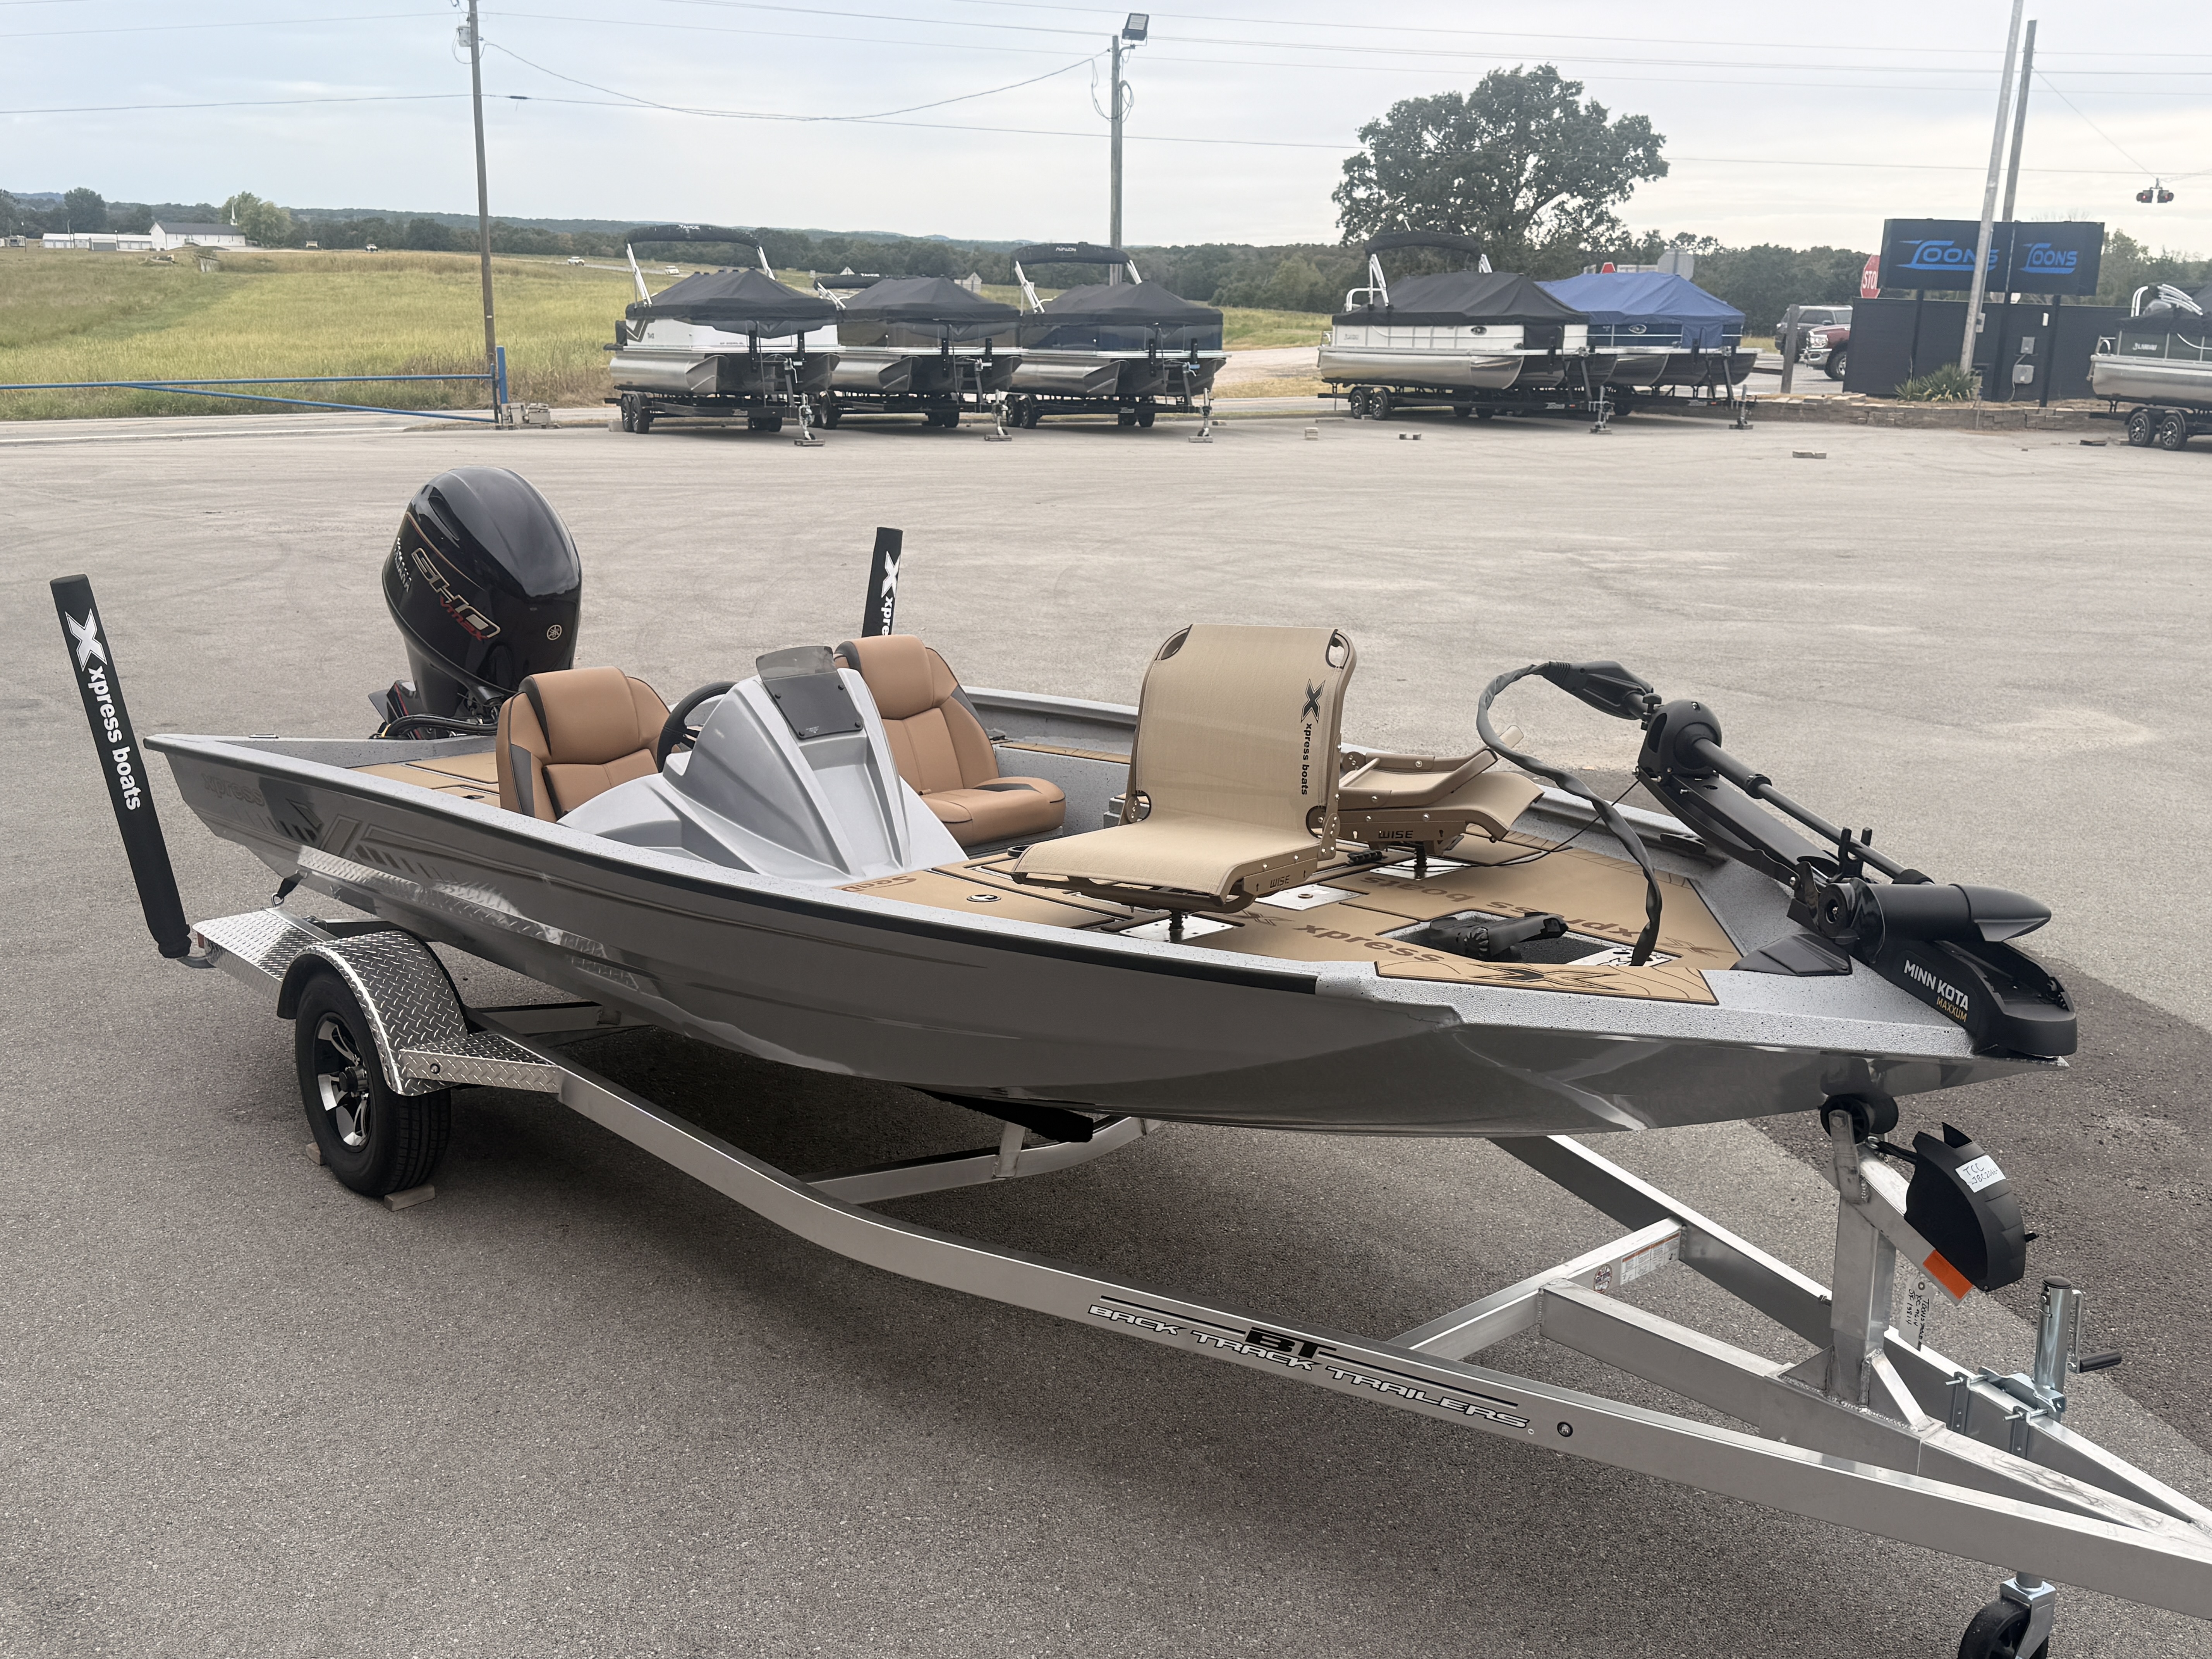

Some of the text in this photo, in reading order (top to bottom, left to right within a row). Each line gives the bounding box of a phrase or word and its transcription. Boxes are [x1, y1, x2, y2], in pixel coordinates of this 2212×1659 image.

[2020, 242, 2078, 274] TOONS
[411, 548, 501, 638] SHO
[881, 596, 893, 636] xpre
[88, 665, 141, 811] xpress boats
[1301, 723, 1312, 795] xpress boats
[201, 773, 265, 807] xpress
[1378, 830, 1414, 839] WISE
[841, 876, 917, 892] SeaD
[1270, 875, 1290, 888] WISE
[1360, 876, 1641, 938] xprss boats
[1293, 925, 1445, 962] xpress
[1904, 959, 1968, 1011] MINN KOTA
[1936, 996, 1967, 1022] MAXXUM
[1245, 1326, 1337, 1358] BT
[1088, 1304, 1530, 1429] BACK TRACK TRAILERS
